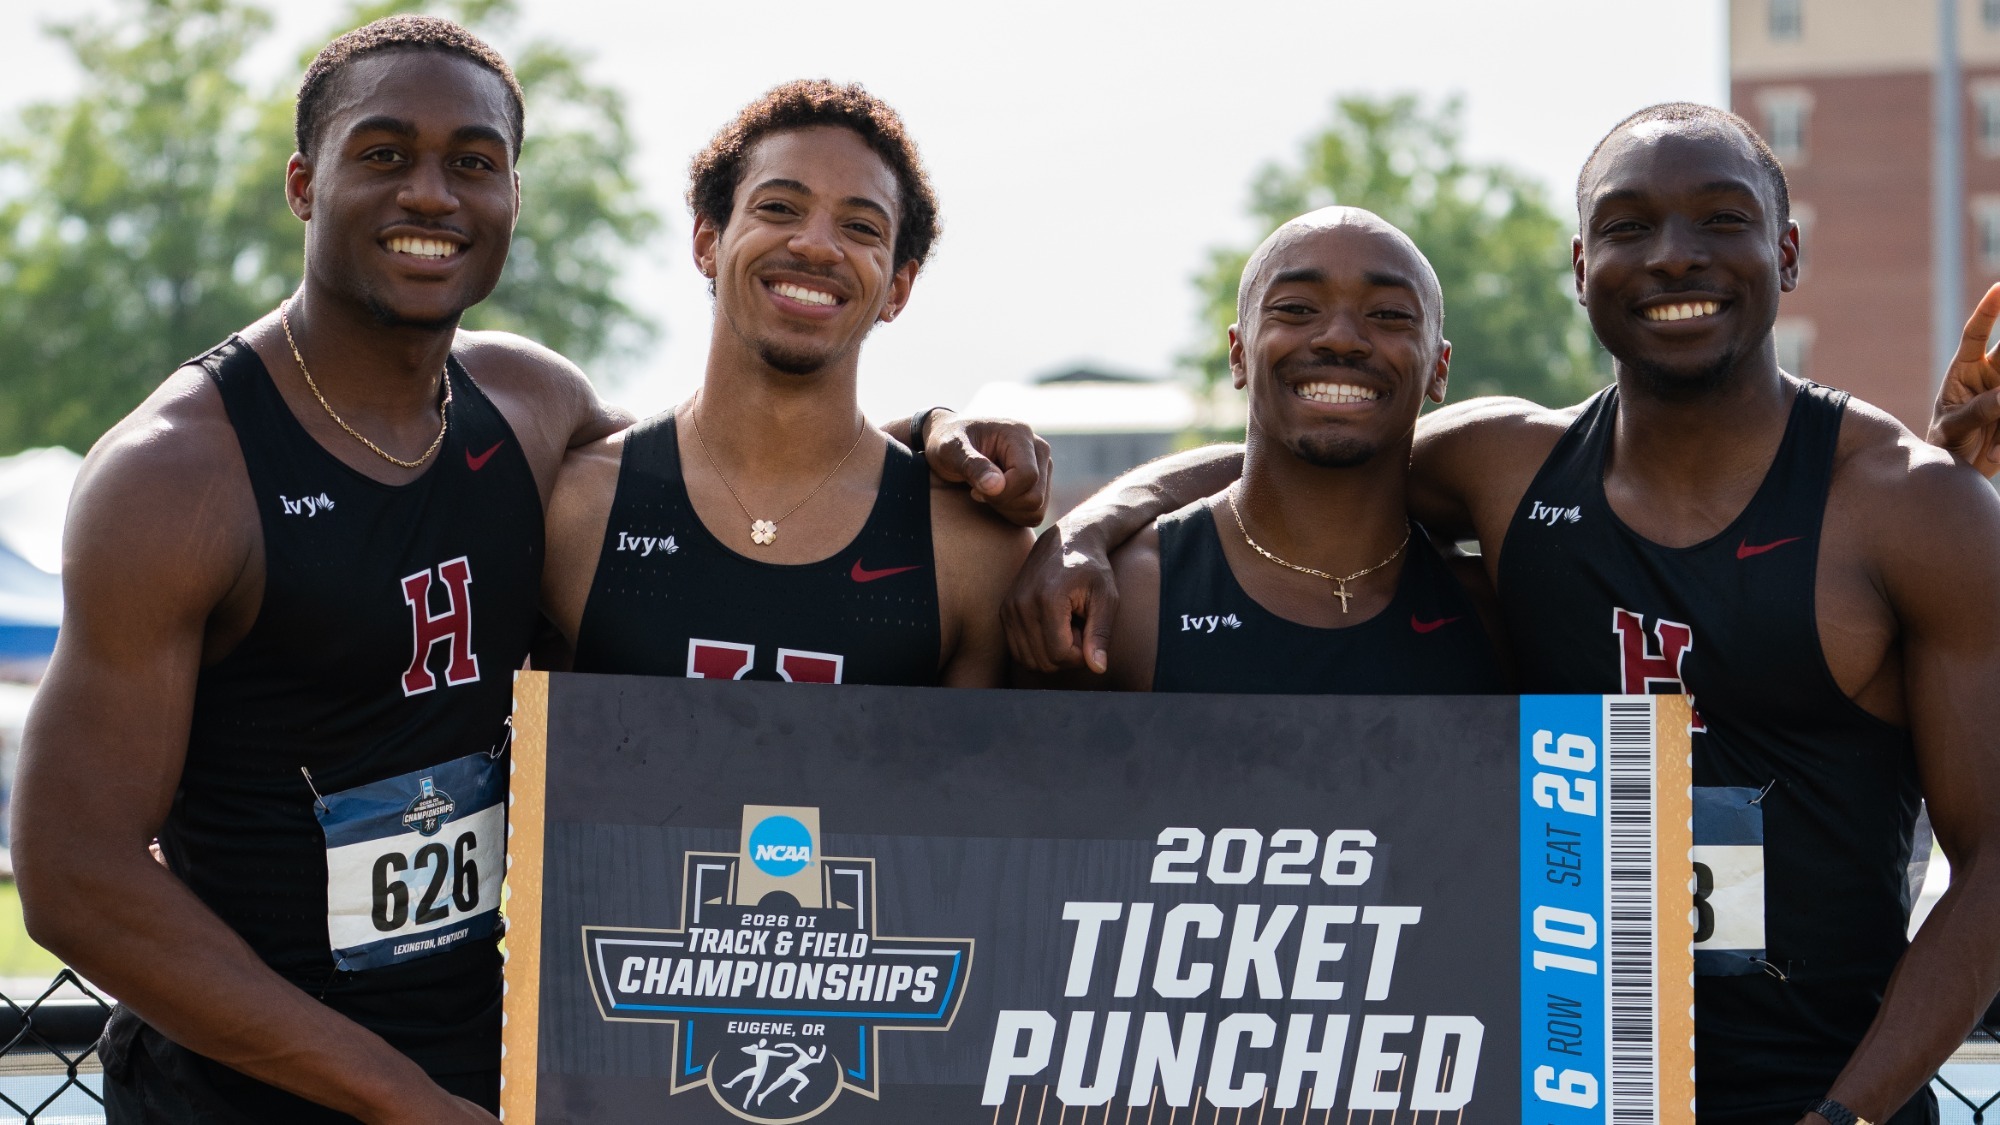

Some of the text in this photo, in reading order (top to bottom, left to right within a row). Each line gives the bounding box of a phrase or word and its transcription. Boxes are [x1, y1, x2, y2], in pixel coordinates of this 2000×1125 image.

[280, 495, 317, 517] Ivy
[1528, 501, 1565, 526] Ivy
[616, 532, 658, 557] Ivy
[401, 555, 480, 697] H
[1181, 614, 1219, 633] Ivy
[404, 803, 453, 823] CHAMPIONSHIPS
[755, 844, 810, 862] NCAA
[1150, 827, 1377, 886] 2026
[371, 831, 479, 932] 626
[741, 913, 817, 928] 2026 DI
[1532, 729, 1598, 1109] 6 ROW 10 SEAT 26
[393, 928, 469, 956] LEXINGTON, KENTUCKY
[688, 927, 869, 958] TRACK & FIELD
[1062, 901, 1422, 1000] TICKET
[618, 956, 939, 1003] CHAMPIONSHIPS
[727, 1021, 825, 1038] EUGENE, OR
[980, 1010, 1485, 1111] PUNCHED
